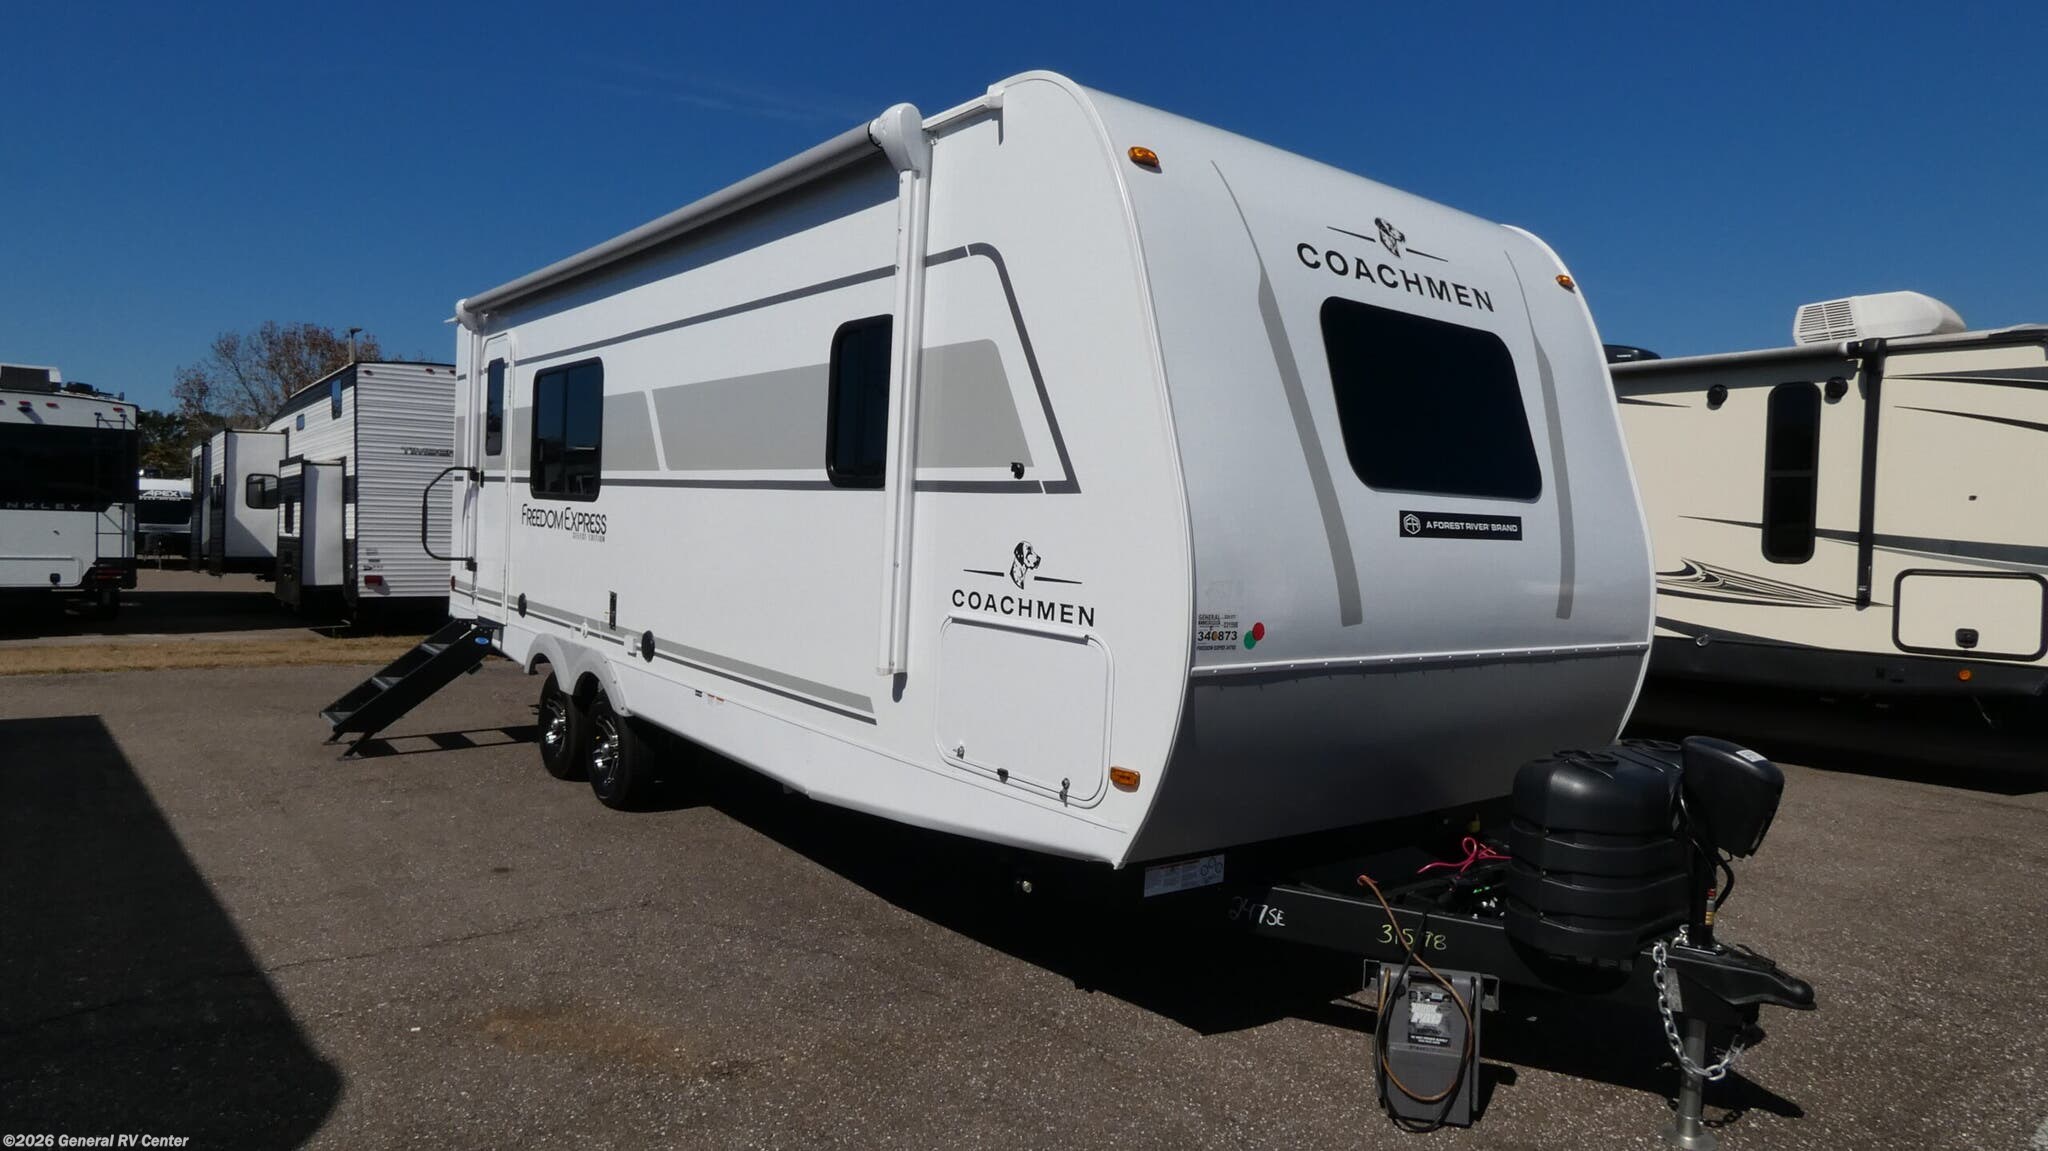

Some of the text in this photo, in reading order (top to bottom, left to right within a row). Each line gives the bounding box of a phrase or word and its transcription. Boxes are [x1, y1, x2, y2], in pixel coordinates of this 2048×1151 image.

[1297, 243, 1494, 312] COACHMEN
[1426, 521, 1518, 532] A FOREST RIVER BRAND
[952, 589, 1094, 627] COACHMEN
